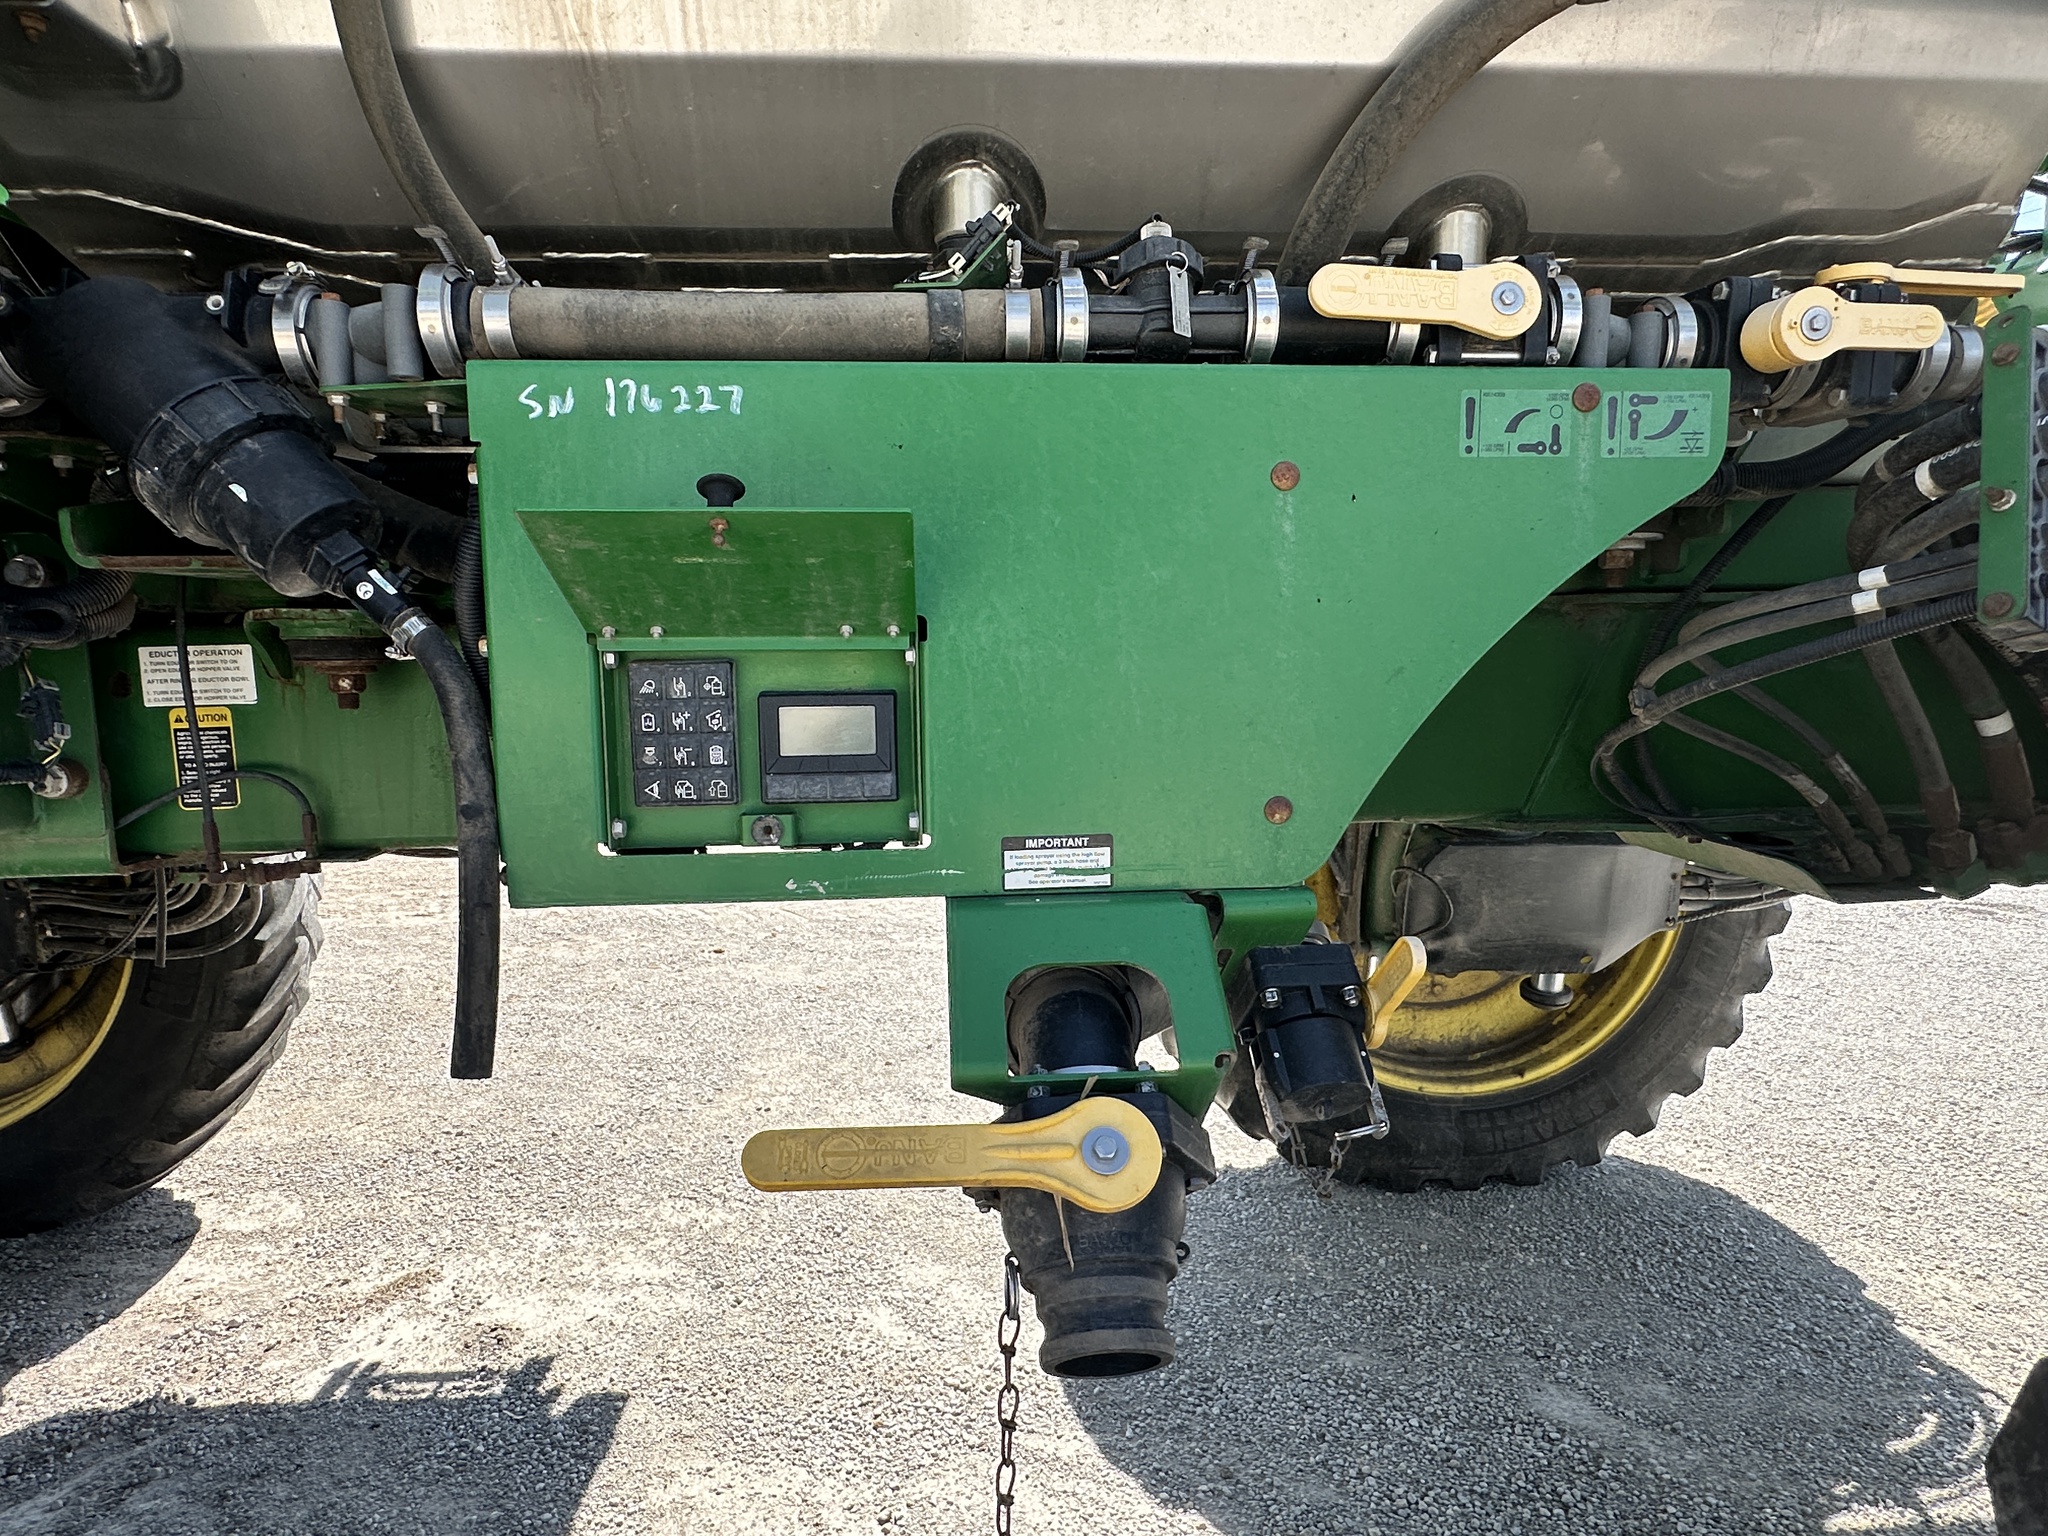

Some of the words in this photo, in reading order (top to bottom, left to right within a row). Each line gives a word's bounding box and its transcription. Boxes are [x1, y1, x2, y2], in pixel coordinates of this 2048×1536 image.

[518, 384, 574, 419] SN
[149, 649, 191, 658] EDUCTR
[193, 649, 243, 657] OPERATION
[1025, 837, 1090, 848] IMPORTANT
